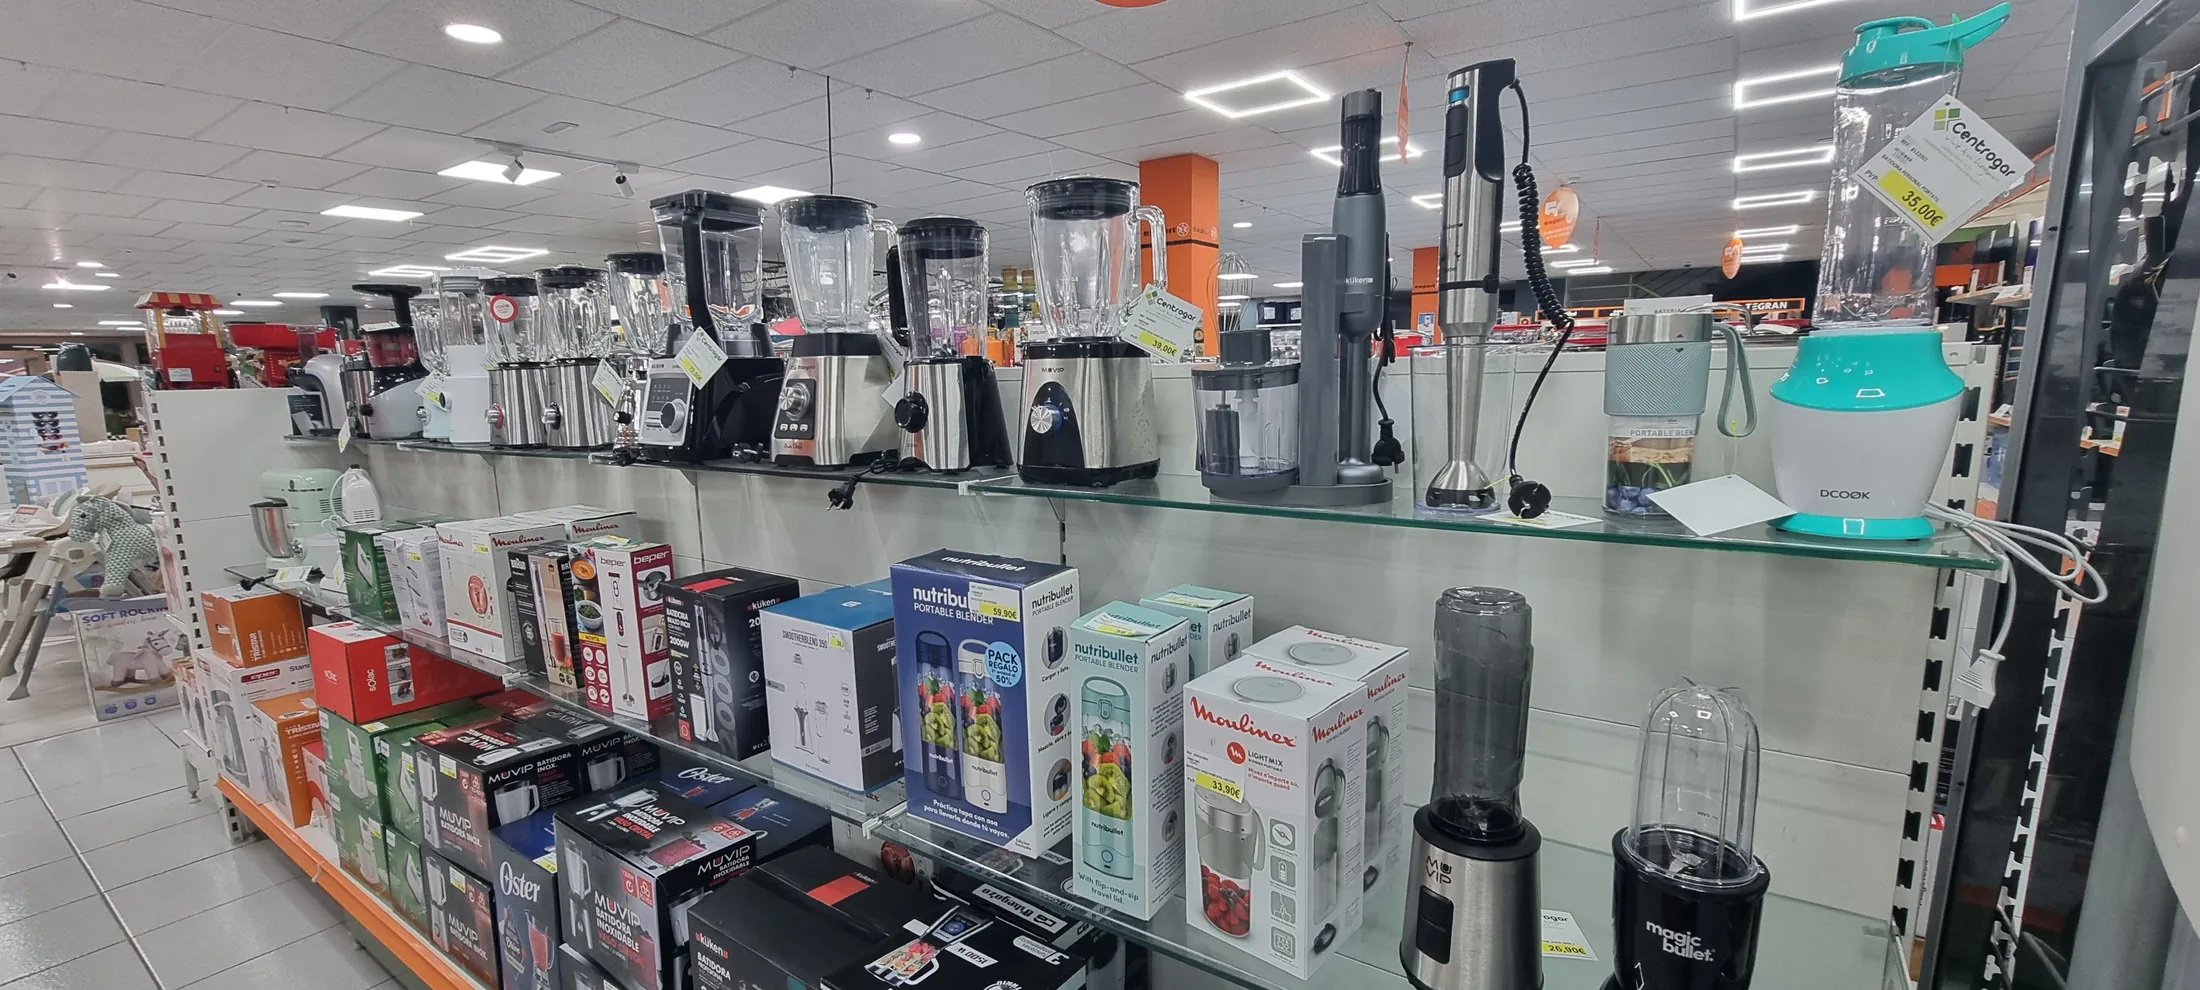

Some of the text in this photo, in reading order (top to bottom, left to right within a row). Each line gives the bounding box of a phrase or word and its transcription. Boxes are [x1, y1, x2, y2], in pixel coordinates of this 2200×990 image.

[1952, 122, 2015, 178] Centrogar
[1901, 190, 1943, 227] 35,00€
[1156, 297, 1196, 321] Centrogar
[1152, 339, 1177, 356] 39,00€
[1630, 429, 1696, 437] PORTABLE BLEN
[572, 522, 620, 535] Moulinex
[491, 534, 546, 548] Moulinex
[600, 556, 627, 568] beper
[634, 550, 670, 565] beper
[941, 555, 1027, 572] nutribullet
[752, 598, 776, 610] küken
[913, 587, 969, 608] nutribu
[1031, 583, 1074, 609] nutribullet
[82, 612, 116, 624] SOFT
[914, 602, 994, 625] PORTABLE BLENDER
[993, 607, 1017, 619] 59,90€
[1212, 608, 1252, 633] nutribullet
[249, 632, 261, 662] TRISTAR
[669, 635, 690, 649] 2000W
[1150, 634, 1188, 664] nutribullet
[1307, 629, 1381, 651] Moulinex
[988, 649, 1018, 666] PACK
[1074, 642, 1139, 665] nutribullet
[1074, 654, 1139, 673] PORTABLE BLENDER
[988, 660, 1018, 673] REGALO
[1254, 660, 1336, 687] Moulinex
[996, 675, 1012, 686] 50%
[1190, 696, 1297, 747] Moulinex
[1312, 707, 1364, 744] Moulinex
[581, 737, 621, 757] MUVIP
[536, 751, 572, 767] BATIDORA
[537, 763, 558, 773] INOX.
[1247, 750, 1284, 767] LIGHTMIX
[488, 763, 534, 785] MUVIP
[678, 766, 733, 785] Oster
[971, 764, 998, 776] nutribullet
[1212, 780, 1241, 799] 33,90€
[439, 806, 472, 831] MUVIP
[640, 804, 686, 825] MUVIP
[440, 819, 467, 839] BATIDORA
[1091, 821, 1124, 836] nutribullet
[697, 845, 750, 876] MUVIP
[713, 860, 750, 880] INOXIDABLE
[719, 854, 750, 872] BATIDORA
[1426, 855, 1452, 875] MU
[499, 861, 540, 903] Oster
[1425, 863, 1452, 883] VIP
[1077, 871, 1139, 901] With flip-and-sip
[1091, 886, 1125, 904] travel lid.
[594, 890, 641, 927] MUVIP
[448, 913, 479, 942] MUVIP
[595, 906, 632, 936] BATIDORA
[596, 917, 641, 953] INOXIDABLE
[1645, 920, 1702, 946] magic
[699, 932, 724, 957] küken
[1548, 944, 1587, 955] 26,90€
[697, 951, 731, 981] BATIDORA
